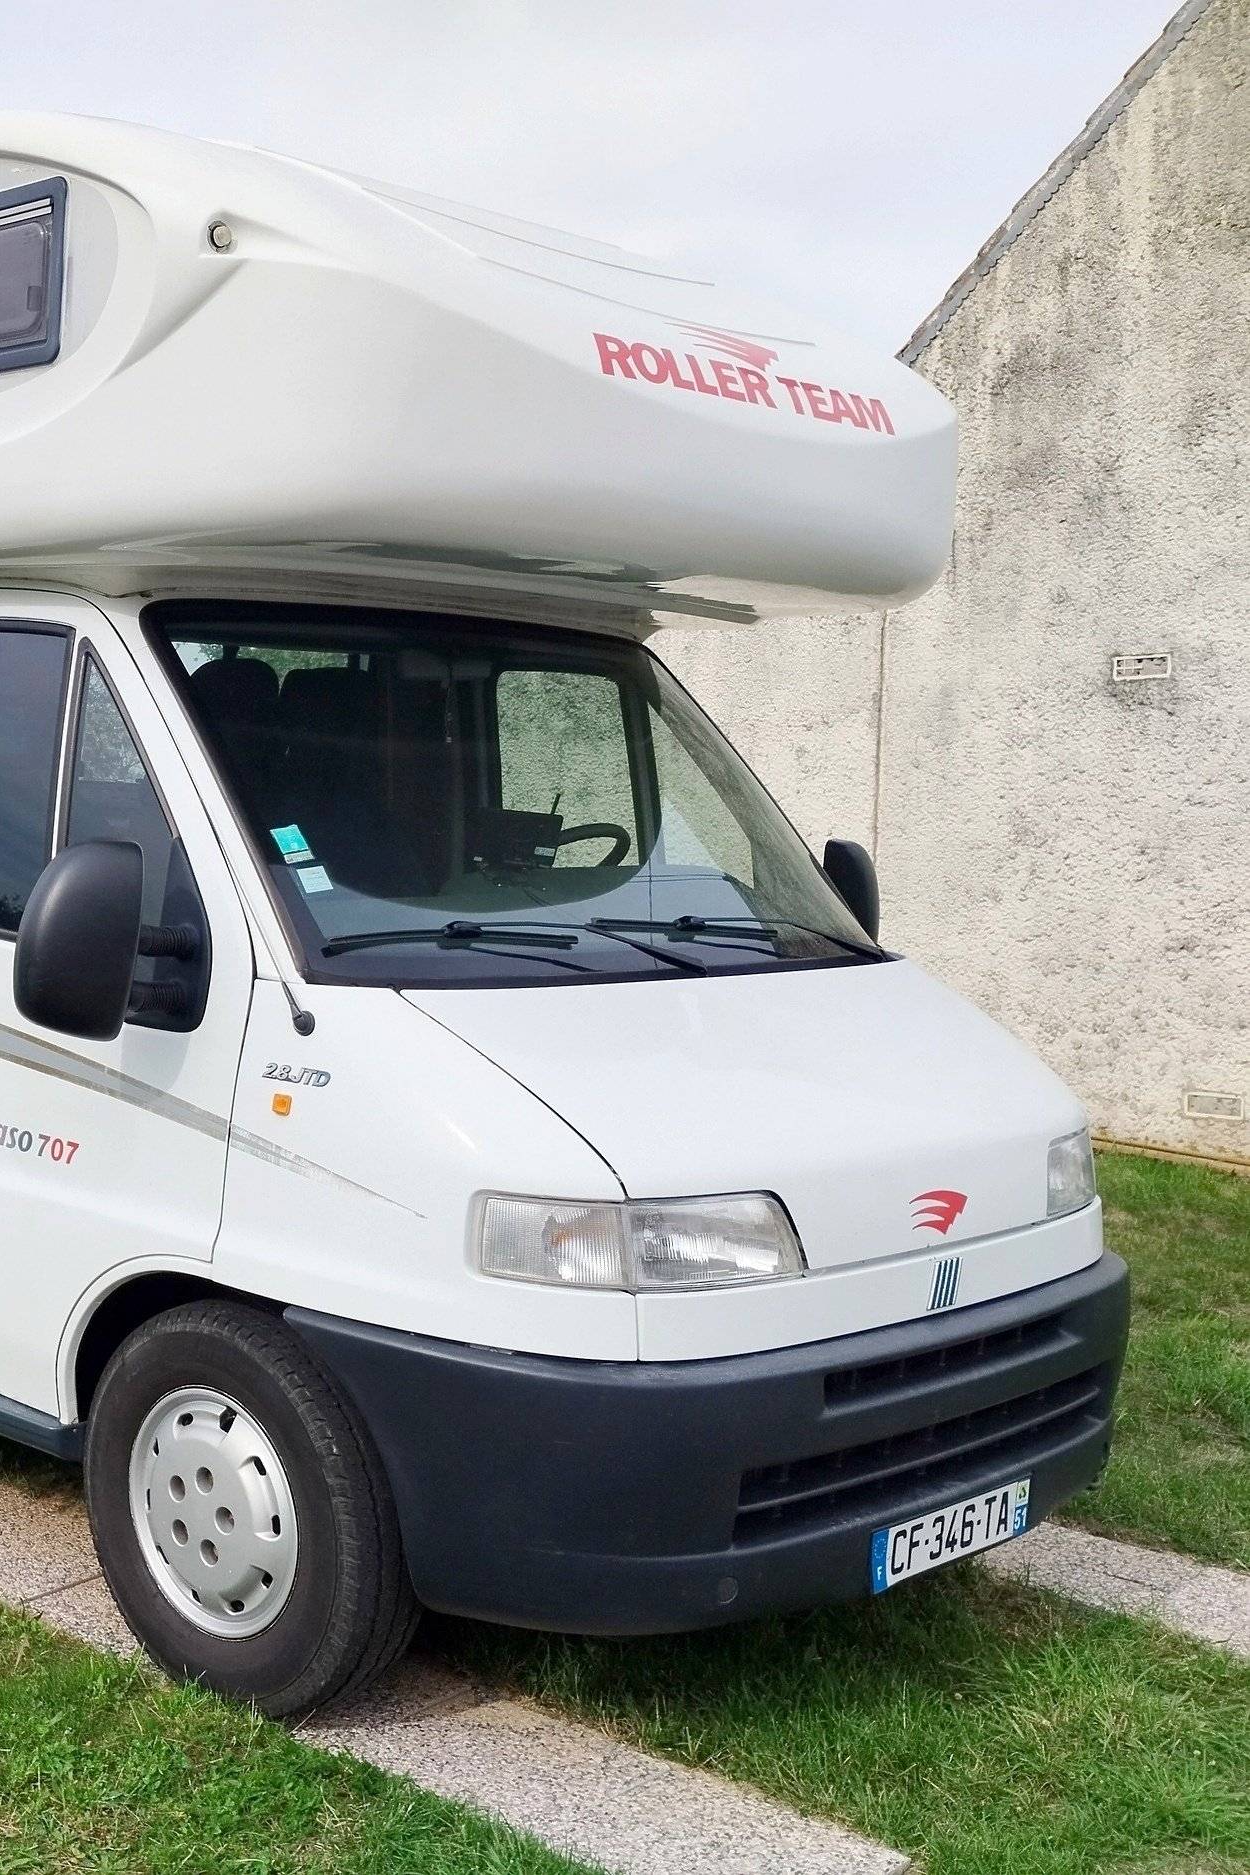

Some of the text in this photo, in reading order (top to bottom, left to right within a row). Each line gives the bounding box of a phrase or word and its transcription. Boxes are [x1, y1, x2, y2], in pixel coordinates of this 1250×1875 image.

[592, 332, 896, 436] ROLLER TEAM
[37, 1133, 80, 1164] 707
[1014, 1506, 1027, 1530] 51
[876, 1566, 883, 1581] F
